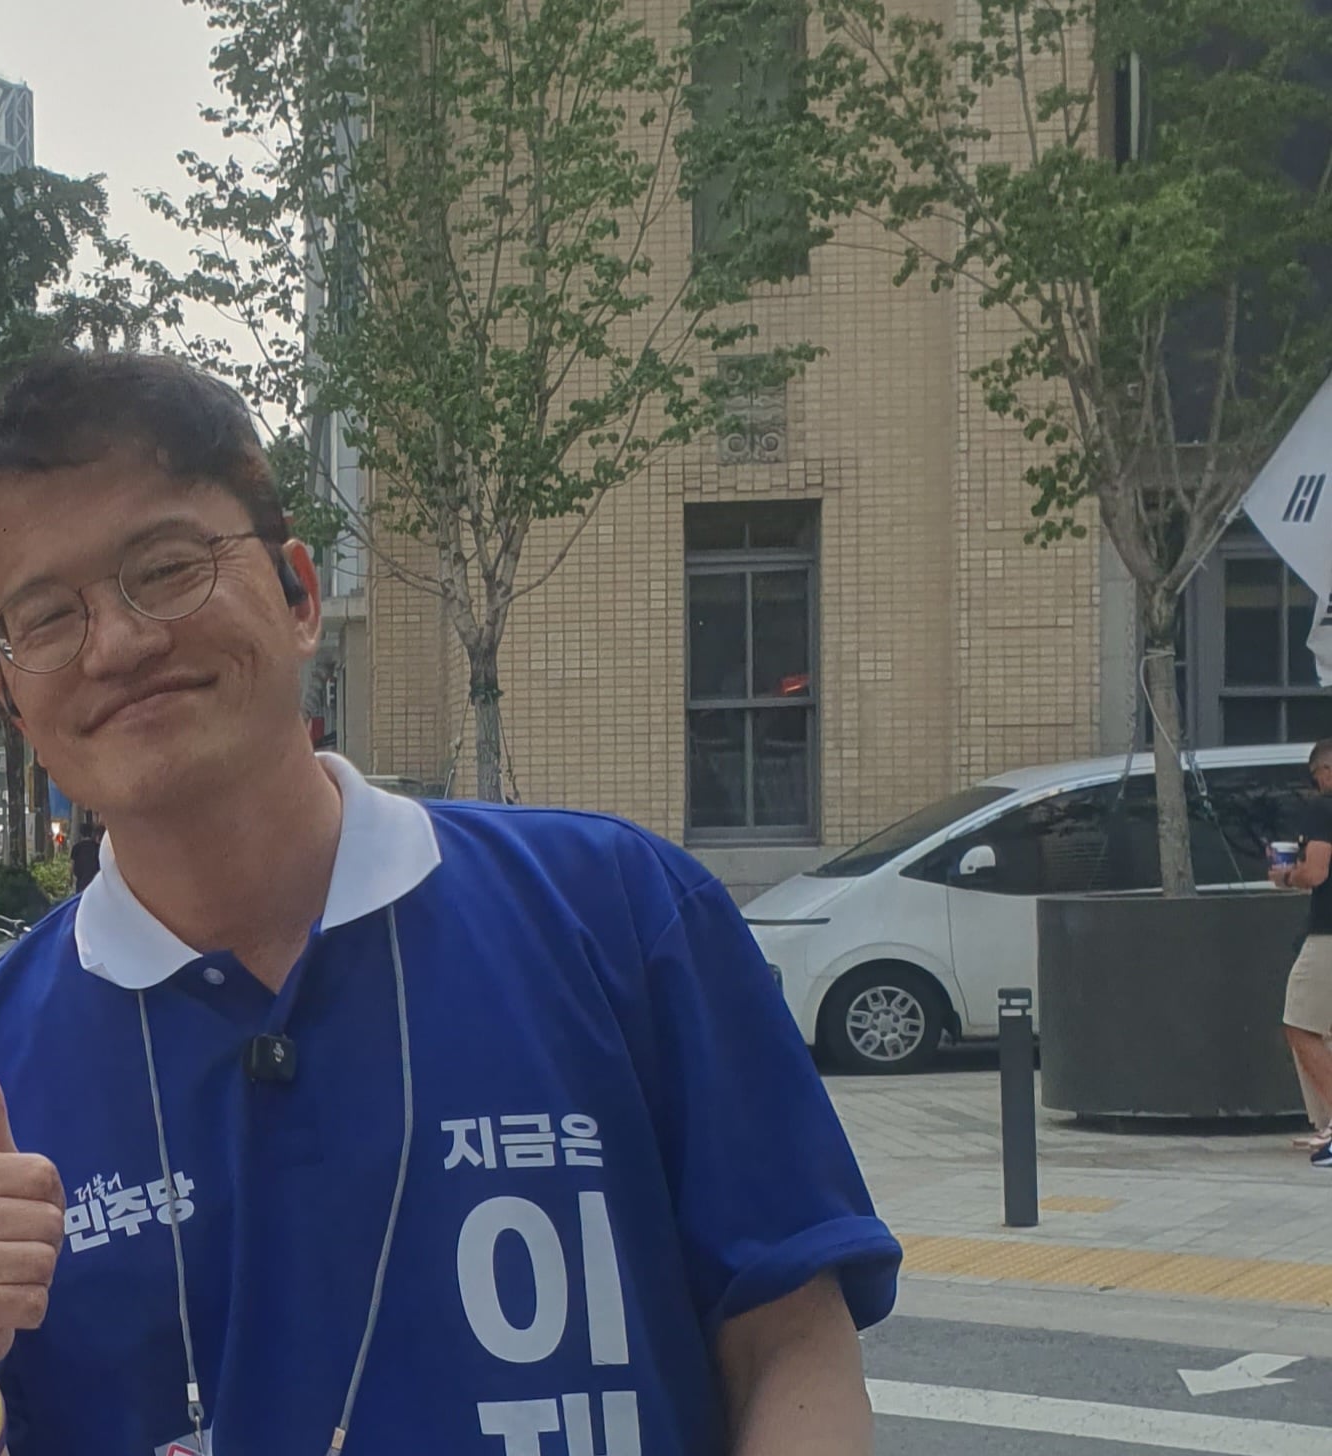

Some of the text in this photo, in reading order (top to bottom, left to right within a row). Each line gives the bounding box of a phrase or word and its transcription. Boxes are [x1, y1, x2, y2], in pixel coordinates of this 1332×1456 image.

[440, 1113, 604, 1170] 지금은
[64, 1171, 195, 1253] 민주당
[73, 1171, 123, 1203] 더불어
